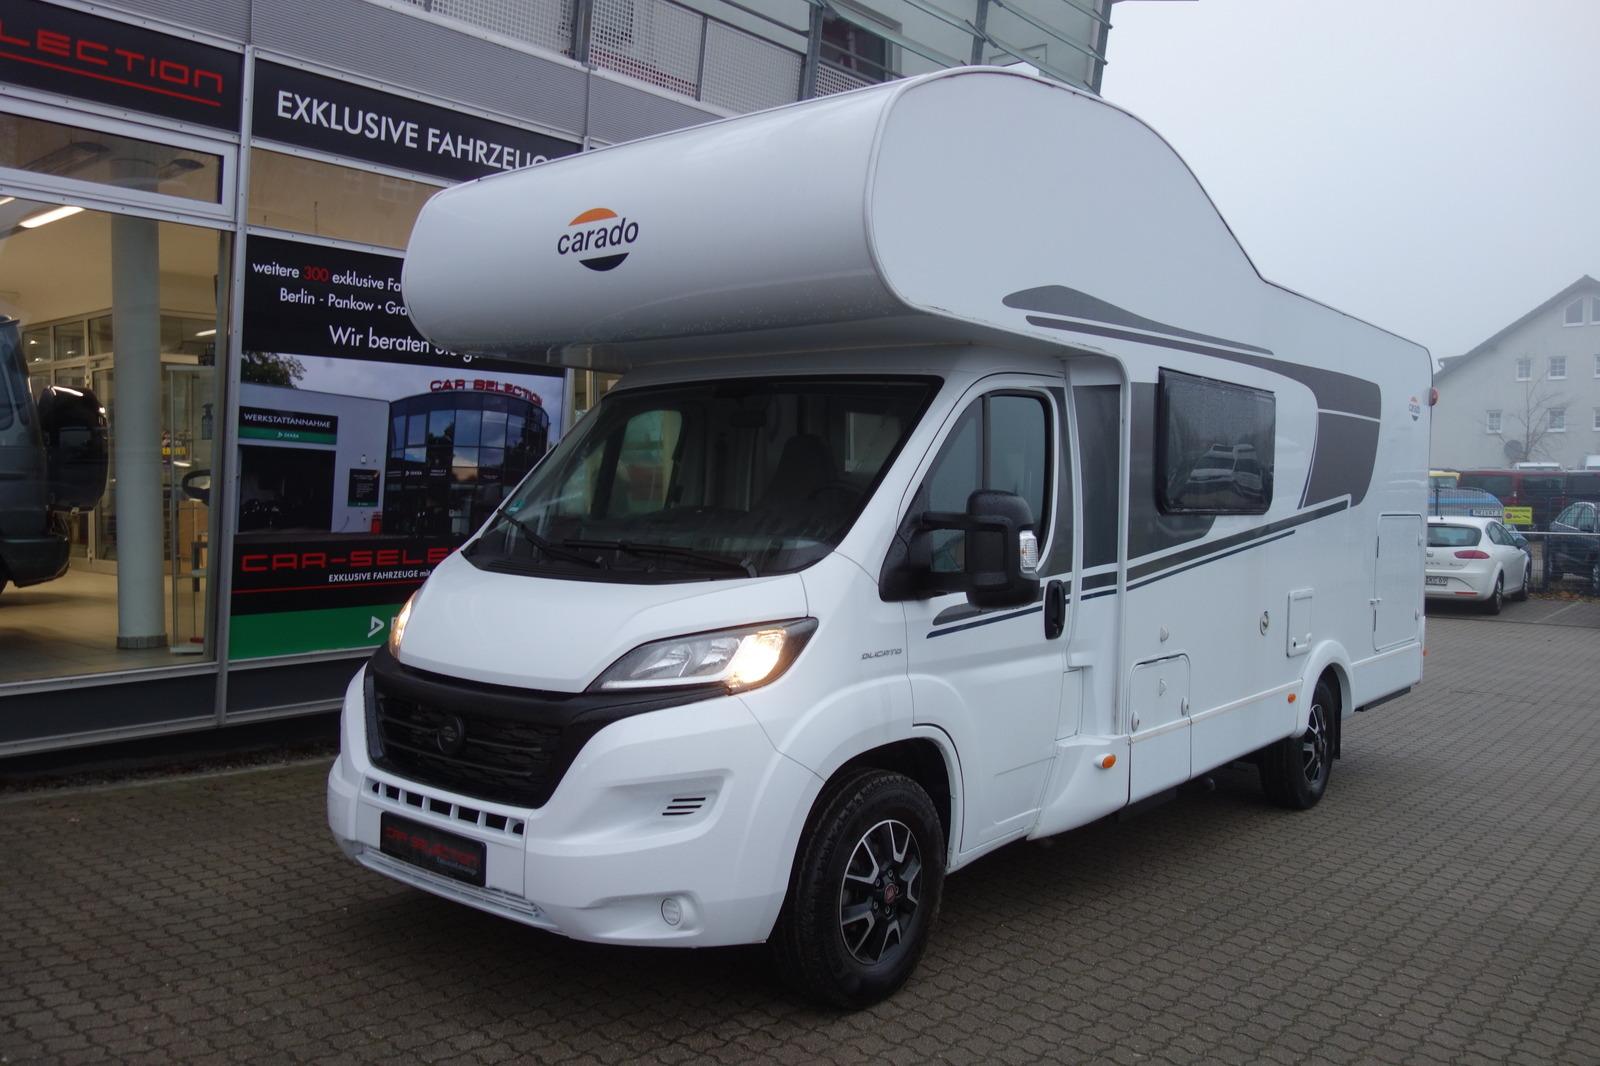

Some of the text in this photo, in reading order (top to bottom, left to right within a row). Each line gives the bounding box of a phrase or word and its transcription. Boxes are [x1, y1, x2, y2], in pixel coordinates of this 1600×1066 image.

[277, 89, 419, 149] EXKLUSIVE
[557, 216, 639, 255] carado
[252, 261, 300, 279] weitere
[303, 265, 329, 282] 300
[331, 270, 385, 290] exklusive
[280, 287, 315, 305] Berlin
[328, 293, 374, 311] Pankow
[329, 324, 363, 347] Wir
[368, 326, 430, 353] beraten
[430, 379, 466, 393] CAR
[243, 412, 332, 429] WERKSTATTANNAHME
[241, 547, 459, 572] CAR-SELE
[328, 571, 371, 583] EXKLUSIVE
[373, 569, 418, 581] FAHRZEUGE
